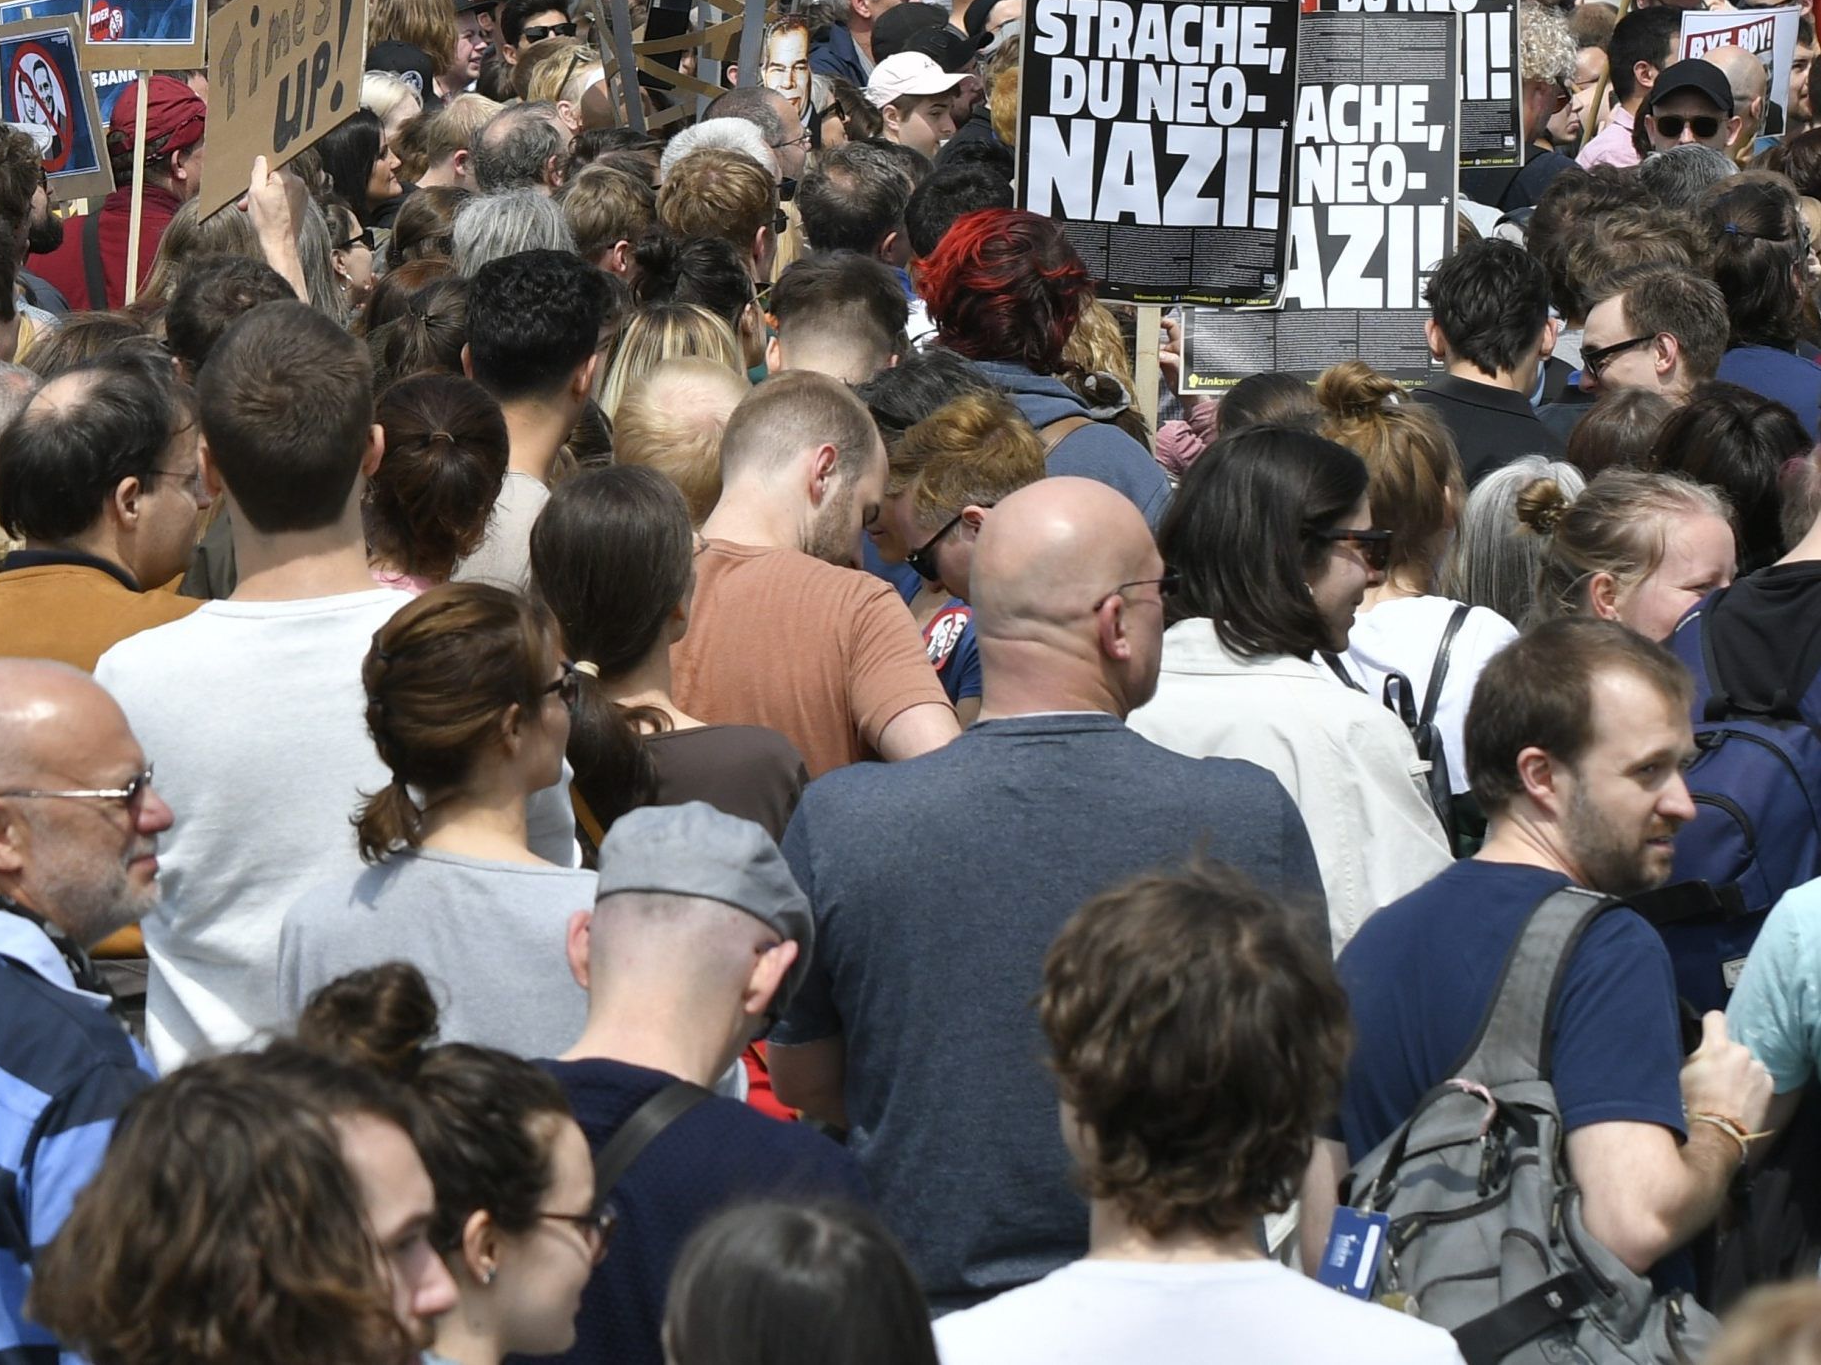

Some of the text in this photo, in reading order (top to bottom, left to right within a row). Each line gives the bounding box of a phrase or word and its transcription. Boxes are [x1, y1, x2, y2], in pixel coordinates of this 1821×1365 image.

[1050, 57, 1267, 126] DU NEO-
[1295, 84, 1445, 152] ACHE,
[1026, 115, 1284, 230] NAZI!
[1299, 144, 1427, 204] NEO-
[1280, 205, 1446, 310] AZI!
